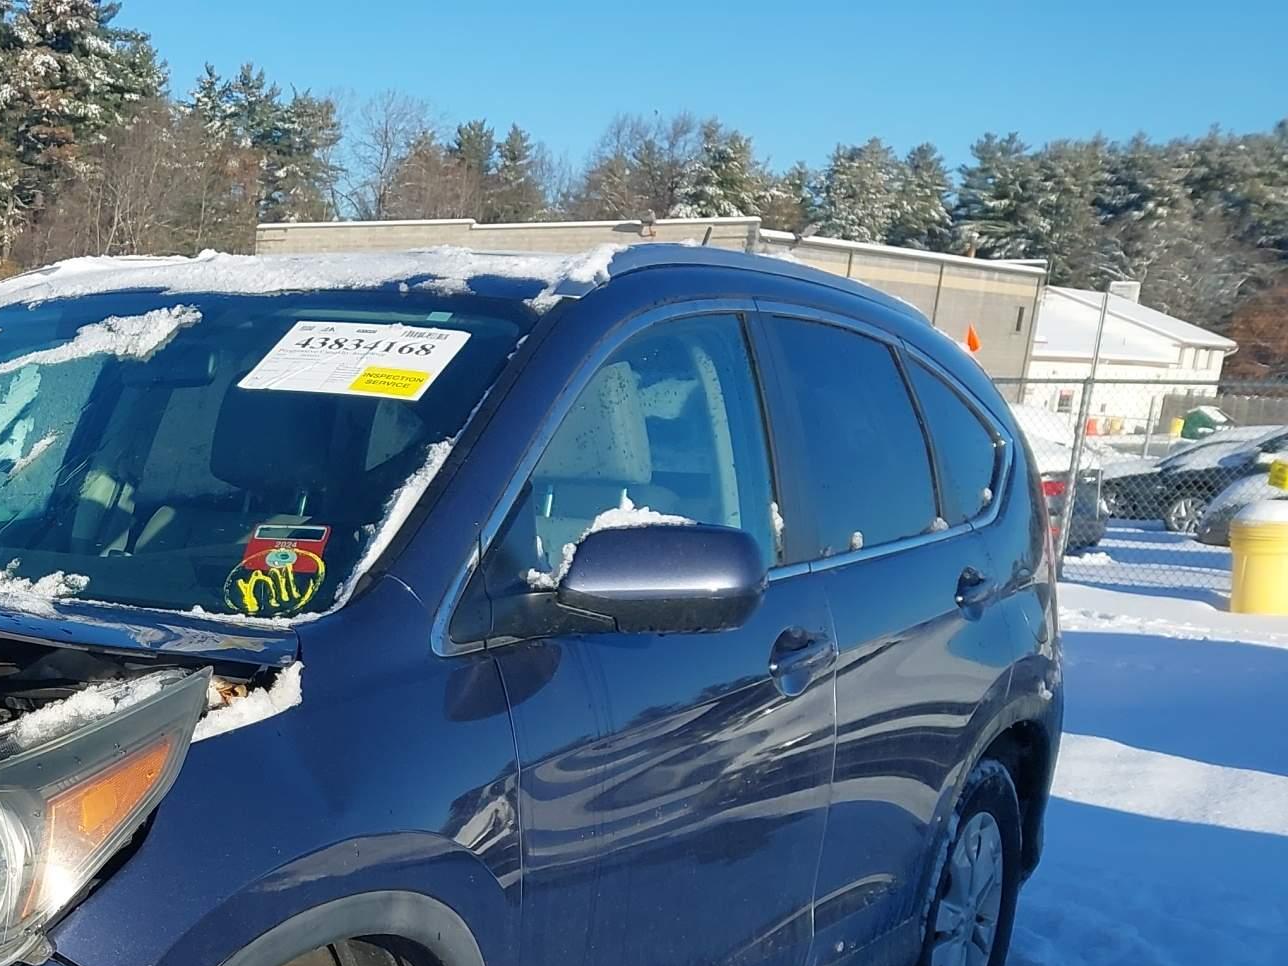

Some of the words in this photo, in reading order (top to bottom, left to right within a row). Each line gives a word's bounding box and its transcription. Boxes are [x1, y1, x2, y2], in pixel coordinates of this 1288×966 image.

[295, 336, 436, 356] 43834168
[363, 371, 425, 383] INSPECTION
[364, 379, 410, 389] SERVICE
